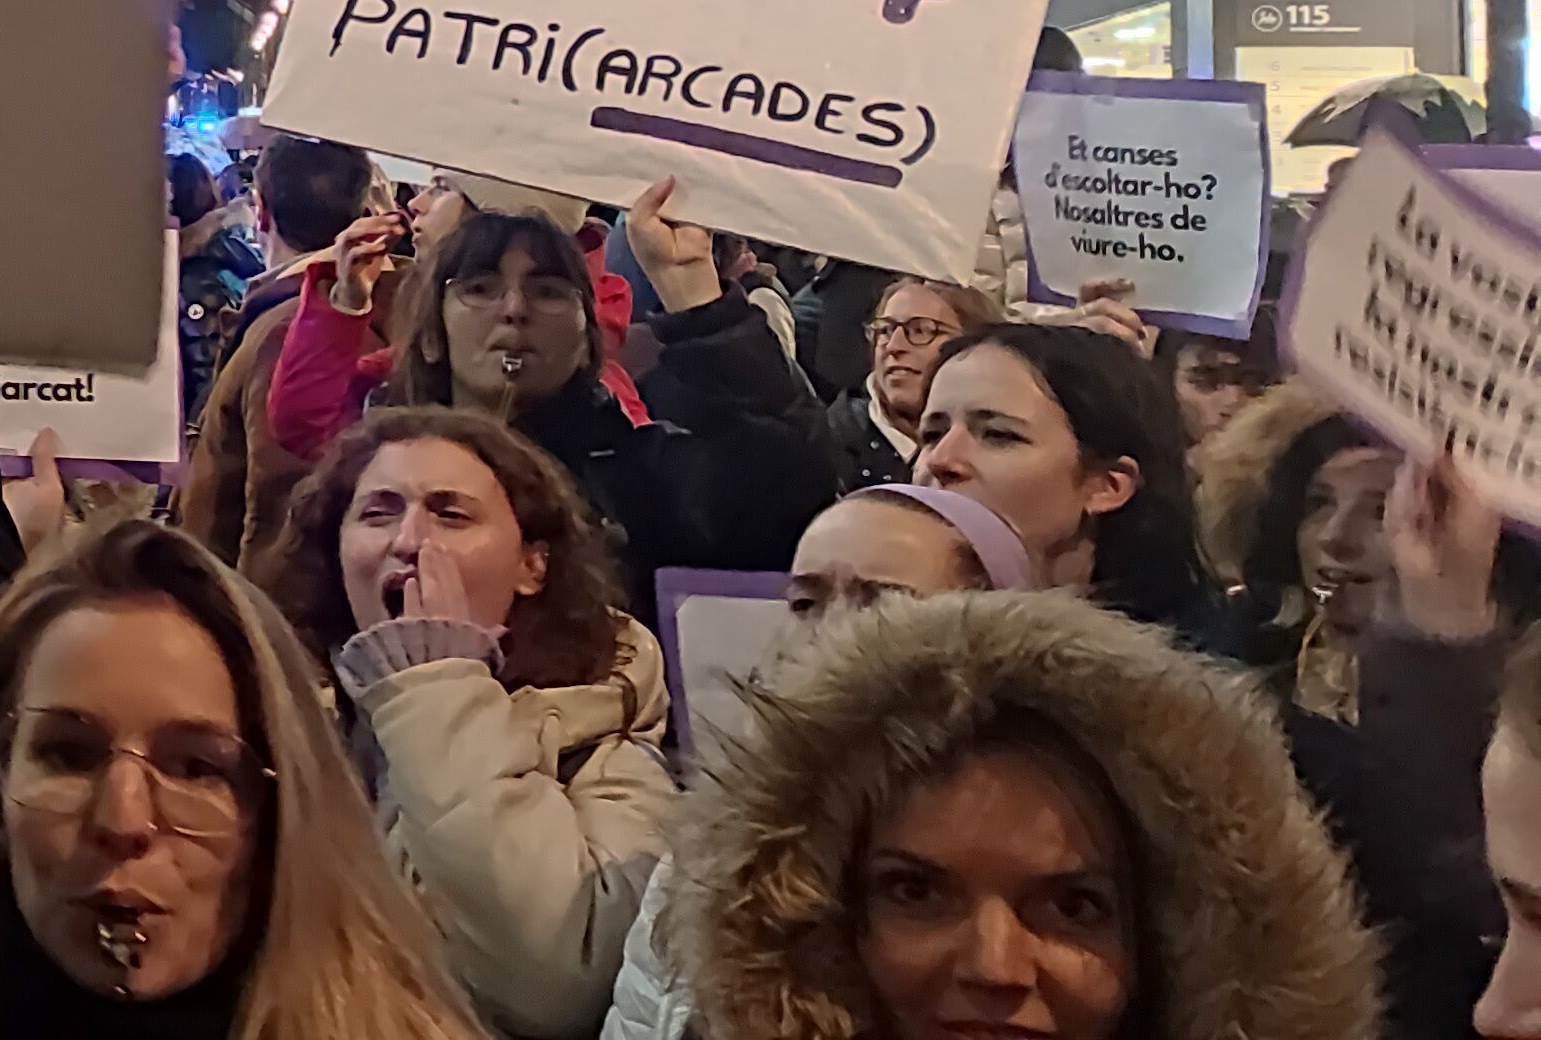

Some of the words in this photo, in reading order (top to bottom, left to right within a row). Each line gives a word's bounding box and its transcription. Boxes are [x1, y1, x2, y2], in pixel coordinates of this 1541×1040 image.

[1285, 4, 1331, 25] 115
[1068, 134, 1087, 160] Et
[1092, 144, 1178, 167] canses
[1044, 161, 1218, 201] d'escoltar-ho?
[1054, 194, 1164, 230] Nosaltres
[1170, 203, 1207, 231] de
[1071, 227, 1185, 262] viure-ho.
